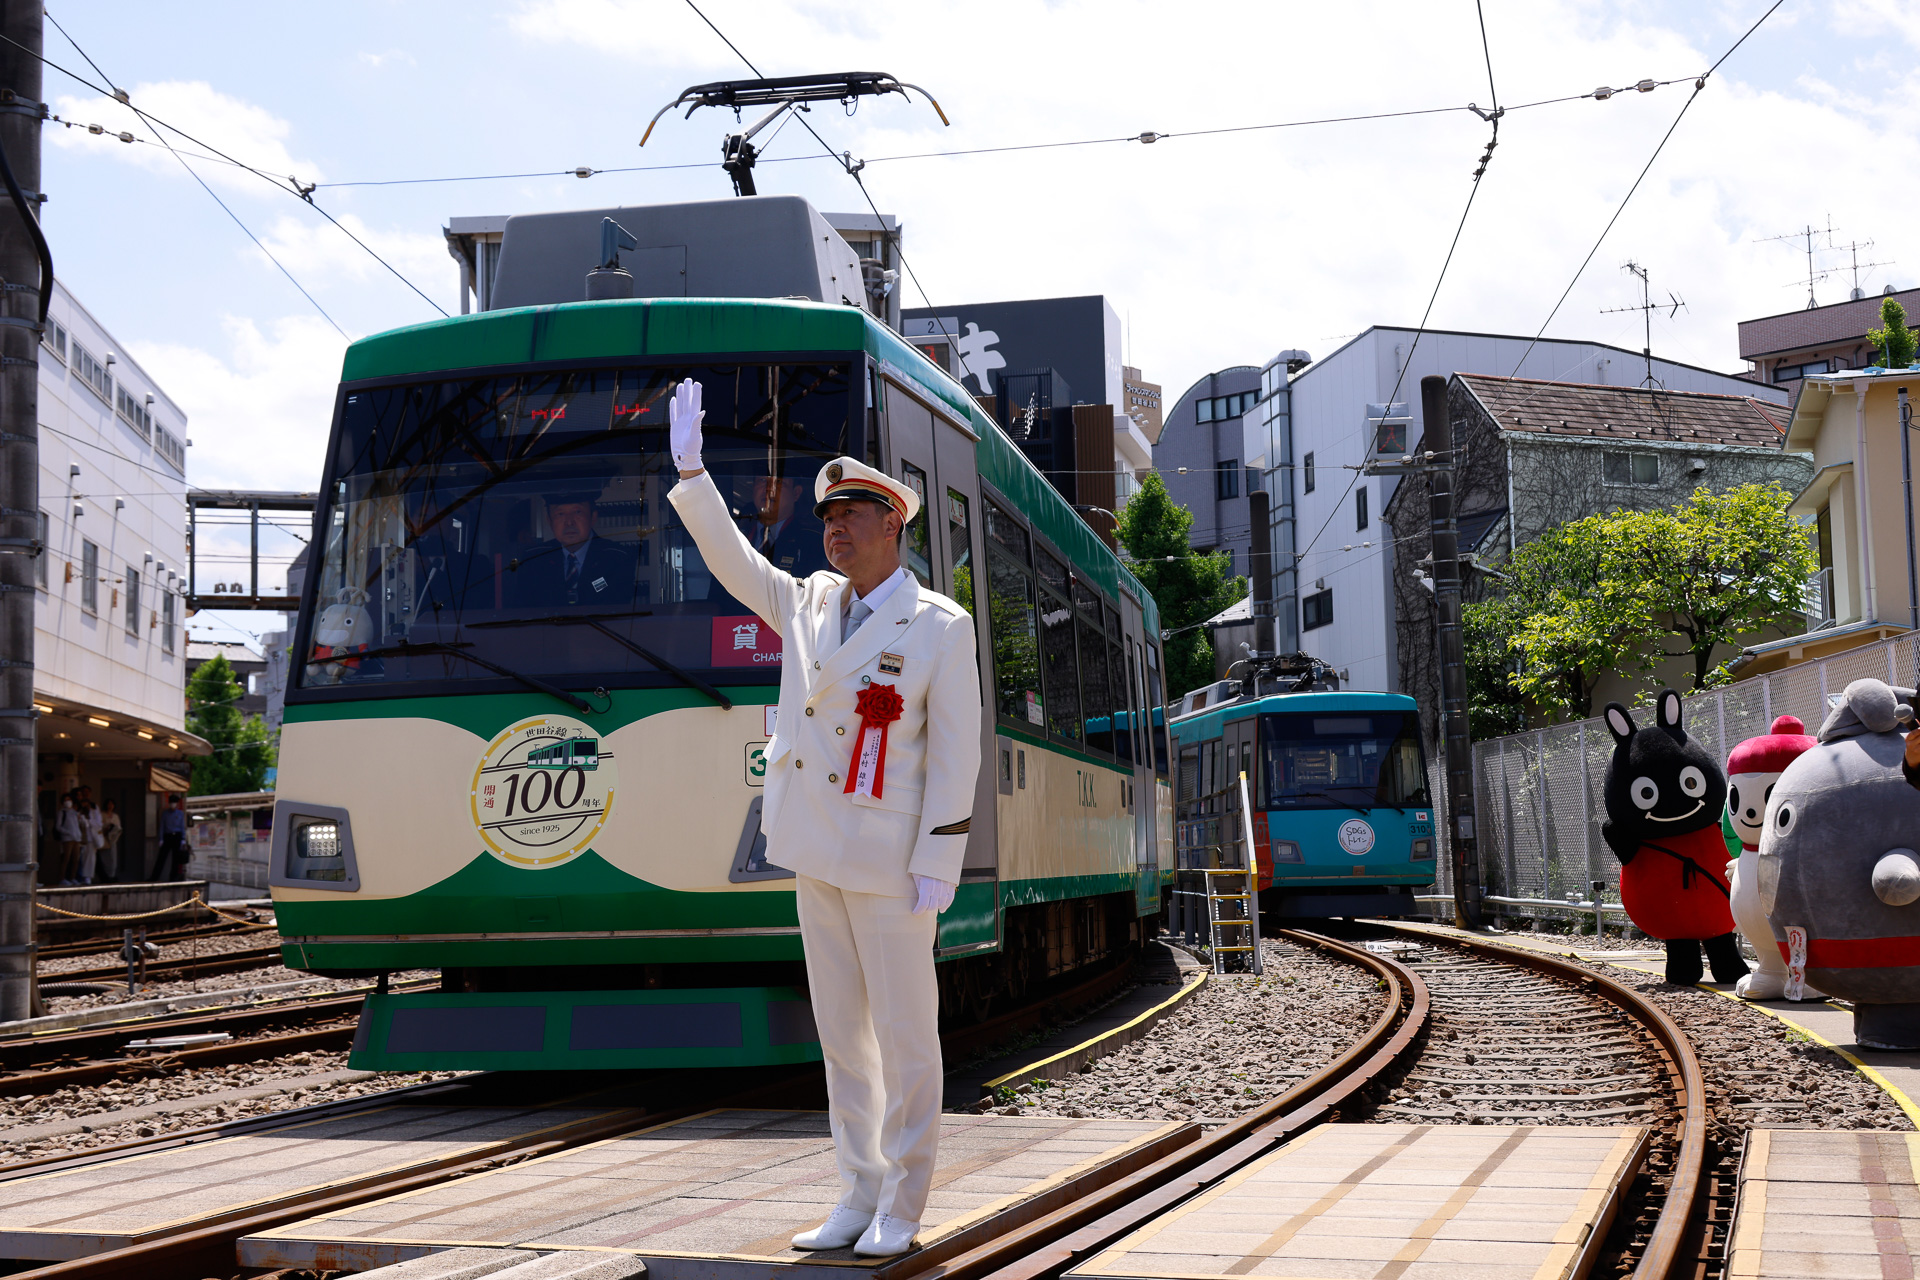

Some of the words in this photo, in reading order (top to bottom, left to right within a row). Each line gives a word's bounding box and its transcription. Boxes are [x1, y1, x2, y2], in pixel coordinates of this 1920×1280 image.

[927, 320, 935, 334] 2
[1125, 382, 1162, 400] ライオンズマンション
[950, 498, 964, 518] 入口
[732, 623, 759, 650] 貸
[752, 652, 783, 663] CHAR
[525, 726, 568, 738] 世田谷線
[750, 749, 767, 777] 3
[483, 784, 496, 809] 開通
[502, 766, 586, 817] 100
[581, 798, 601, 808] 周年
[519, 827, 541, 836] since
[542, 824, 560, 834] 1925
[1346, 826, 1367, 836] SDGs
[1410, 825, 1426, 834] 310
